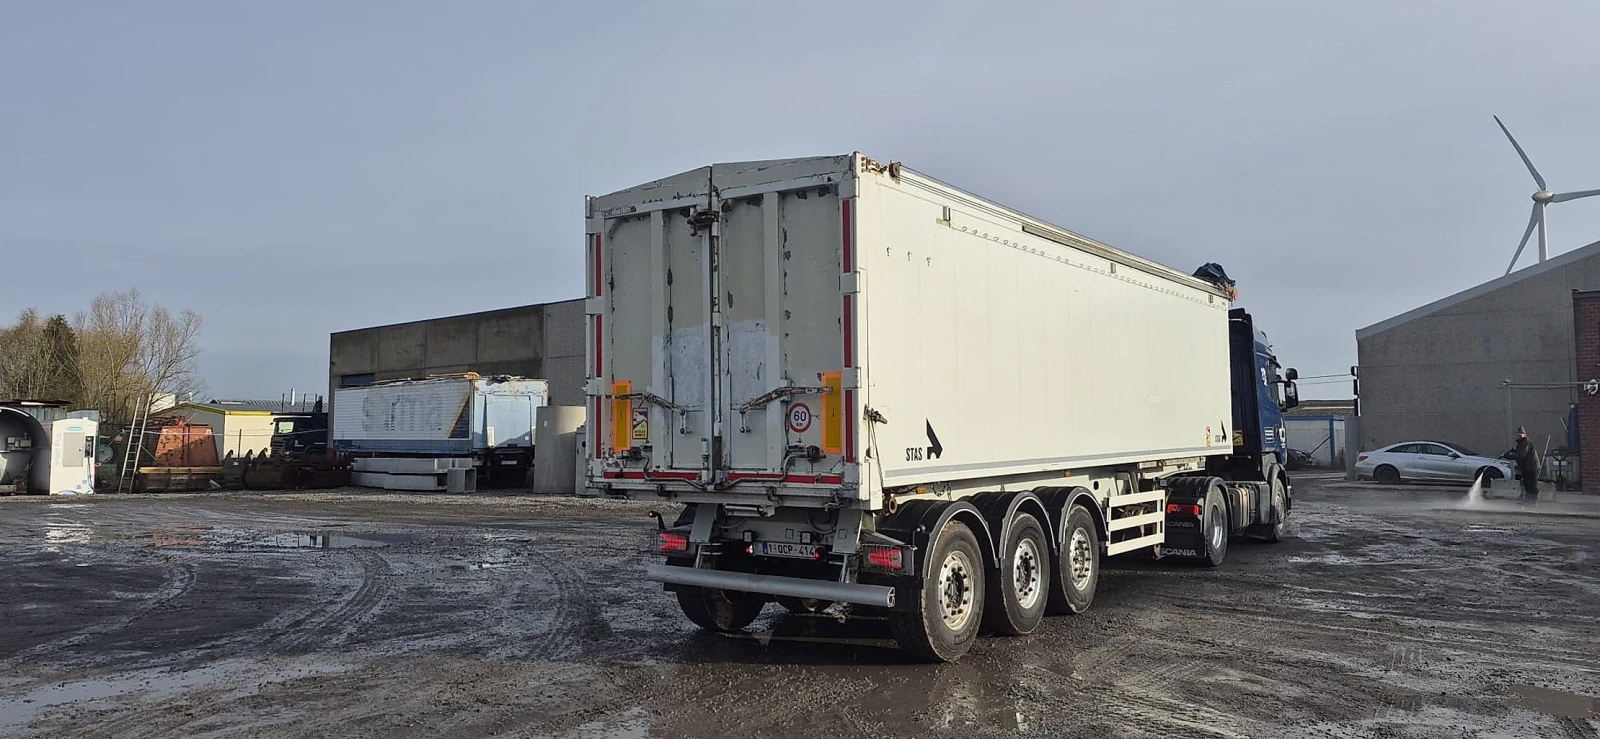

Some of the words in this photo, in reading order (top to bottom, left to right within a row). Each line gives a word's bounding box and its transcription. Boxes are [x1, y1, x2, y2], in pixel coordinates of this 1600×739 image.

[793, 410, 807, 421] 60
[905, 447, 923, 461] STAS
[1166, 520, 1195, 528] CANIA
